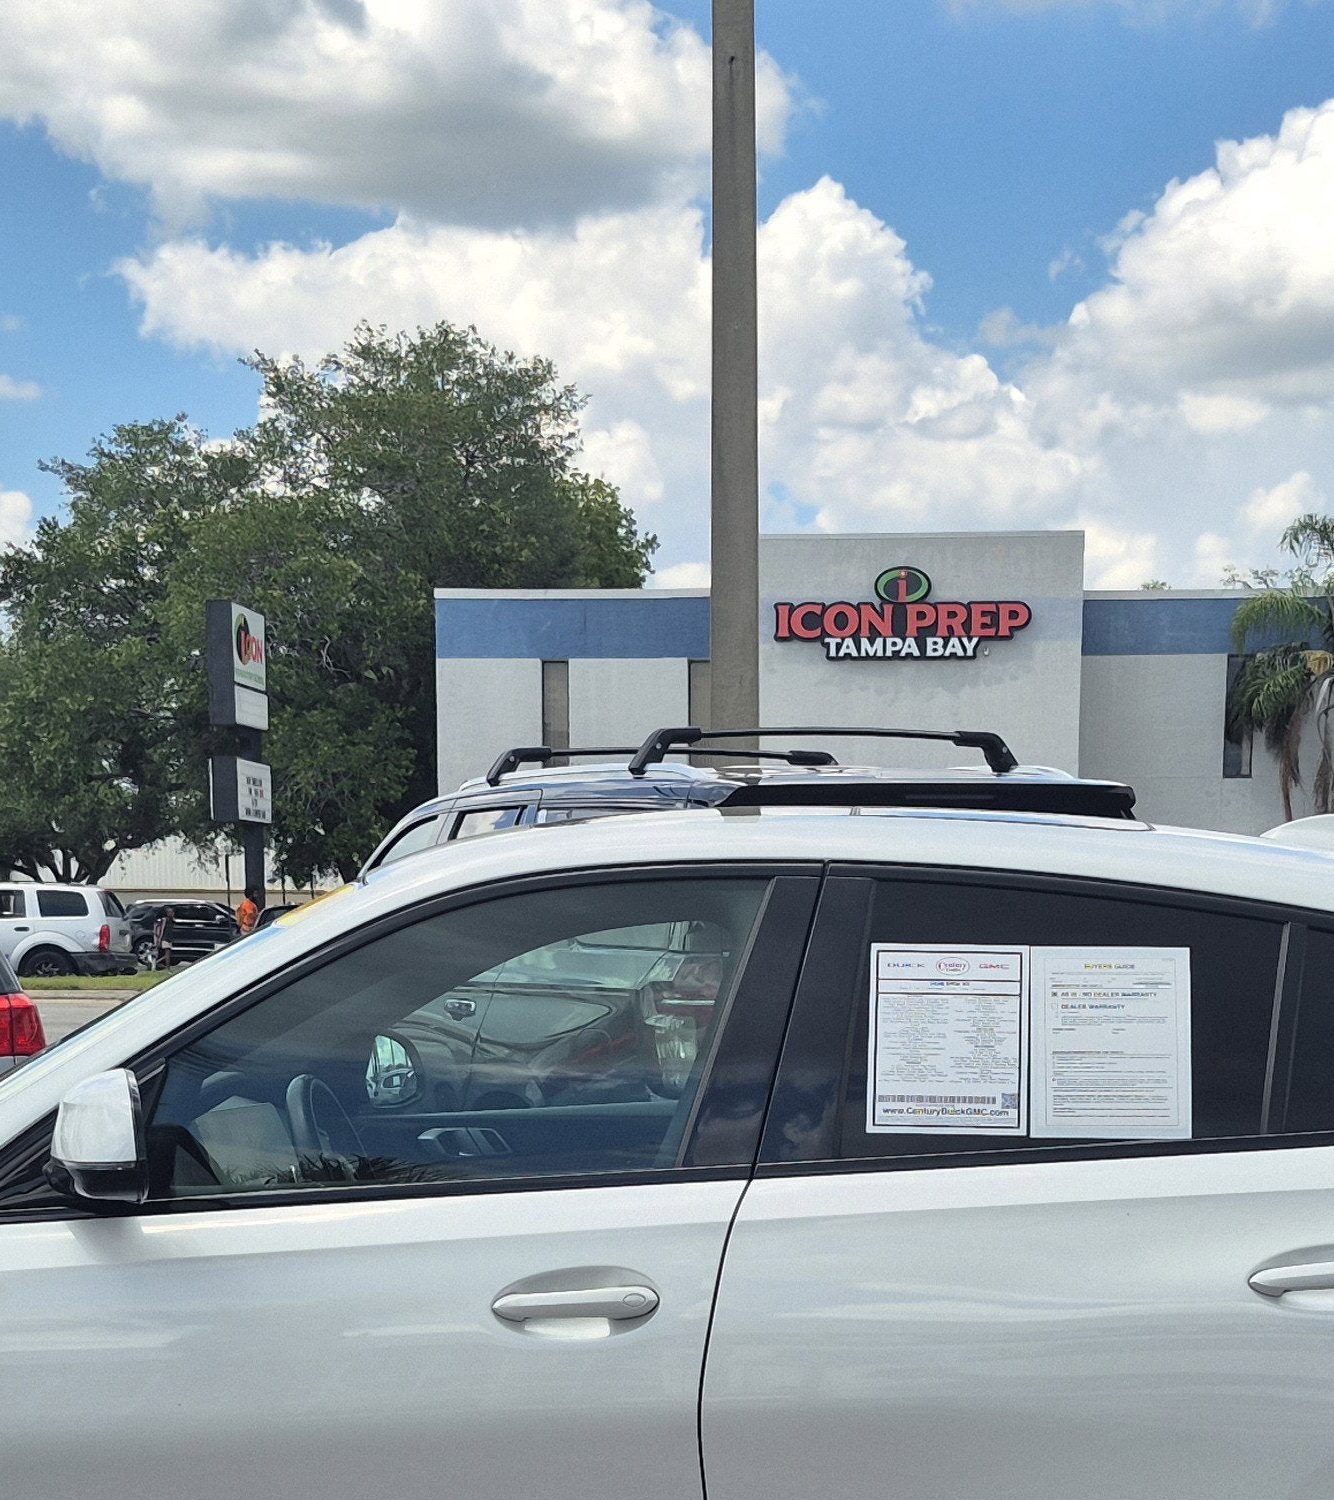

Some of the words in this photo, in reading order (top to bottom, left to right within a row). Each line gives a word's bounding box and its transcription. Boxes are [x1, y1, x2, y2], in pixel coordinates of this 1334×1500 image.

[776, 603, 894, 638] ICON
[905, 603, 1030, 637] PREP
[824, 637, 921, 657] TAMPA
[925, 637, 980, 657] BAY
